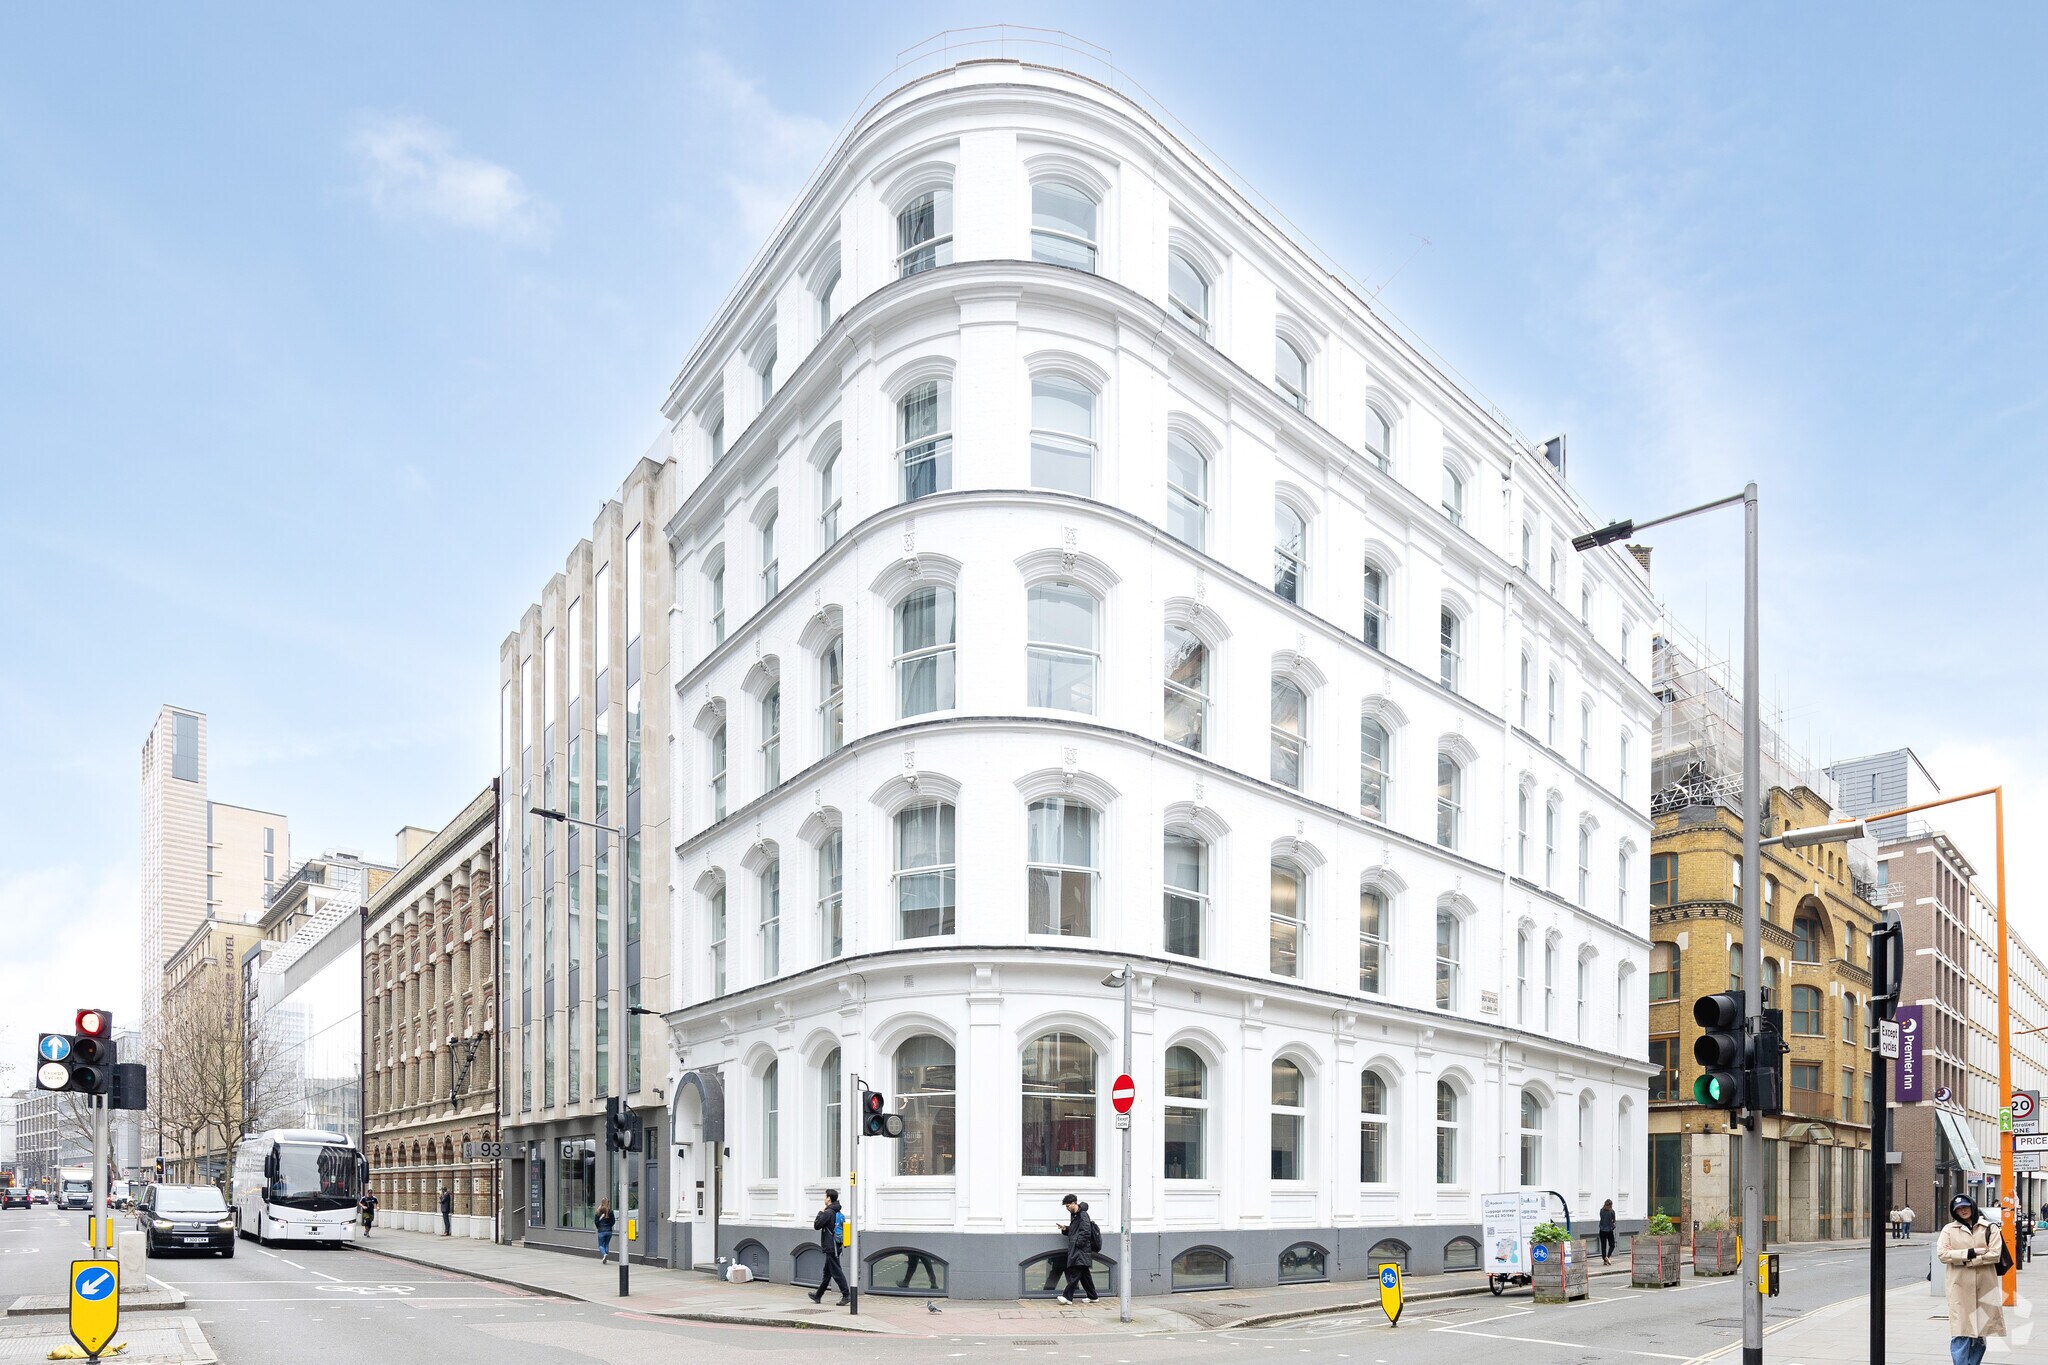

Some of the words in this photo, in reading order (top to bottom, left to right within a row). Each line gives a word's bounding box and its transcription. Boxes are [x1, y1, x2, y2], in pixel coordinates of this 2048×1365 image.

[226, 934, 234, 968] HOTEL
[1882, 1026, 1898, 1039] Except
[1882, 1041, 1897, 1052] cycles
[1904, 1035, 1914, 1073] Premier
[1904, 1074, 1914, 1090] Inn
[2012, 1100, 2030, 1111] 20
[2020, 1136, 2048, 1145] PRICE
[481, 1142, 502, 1157] 93
[1702, 1159, 1712, 1174] 5
